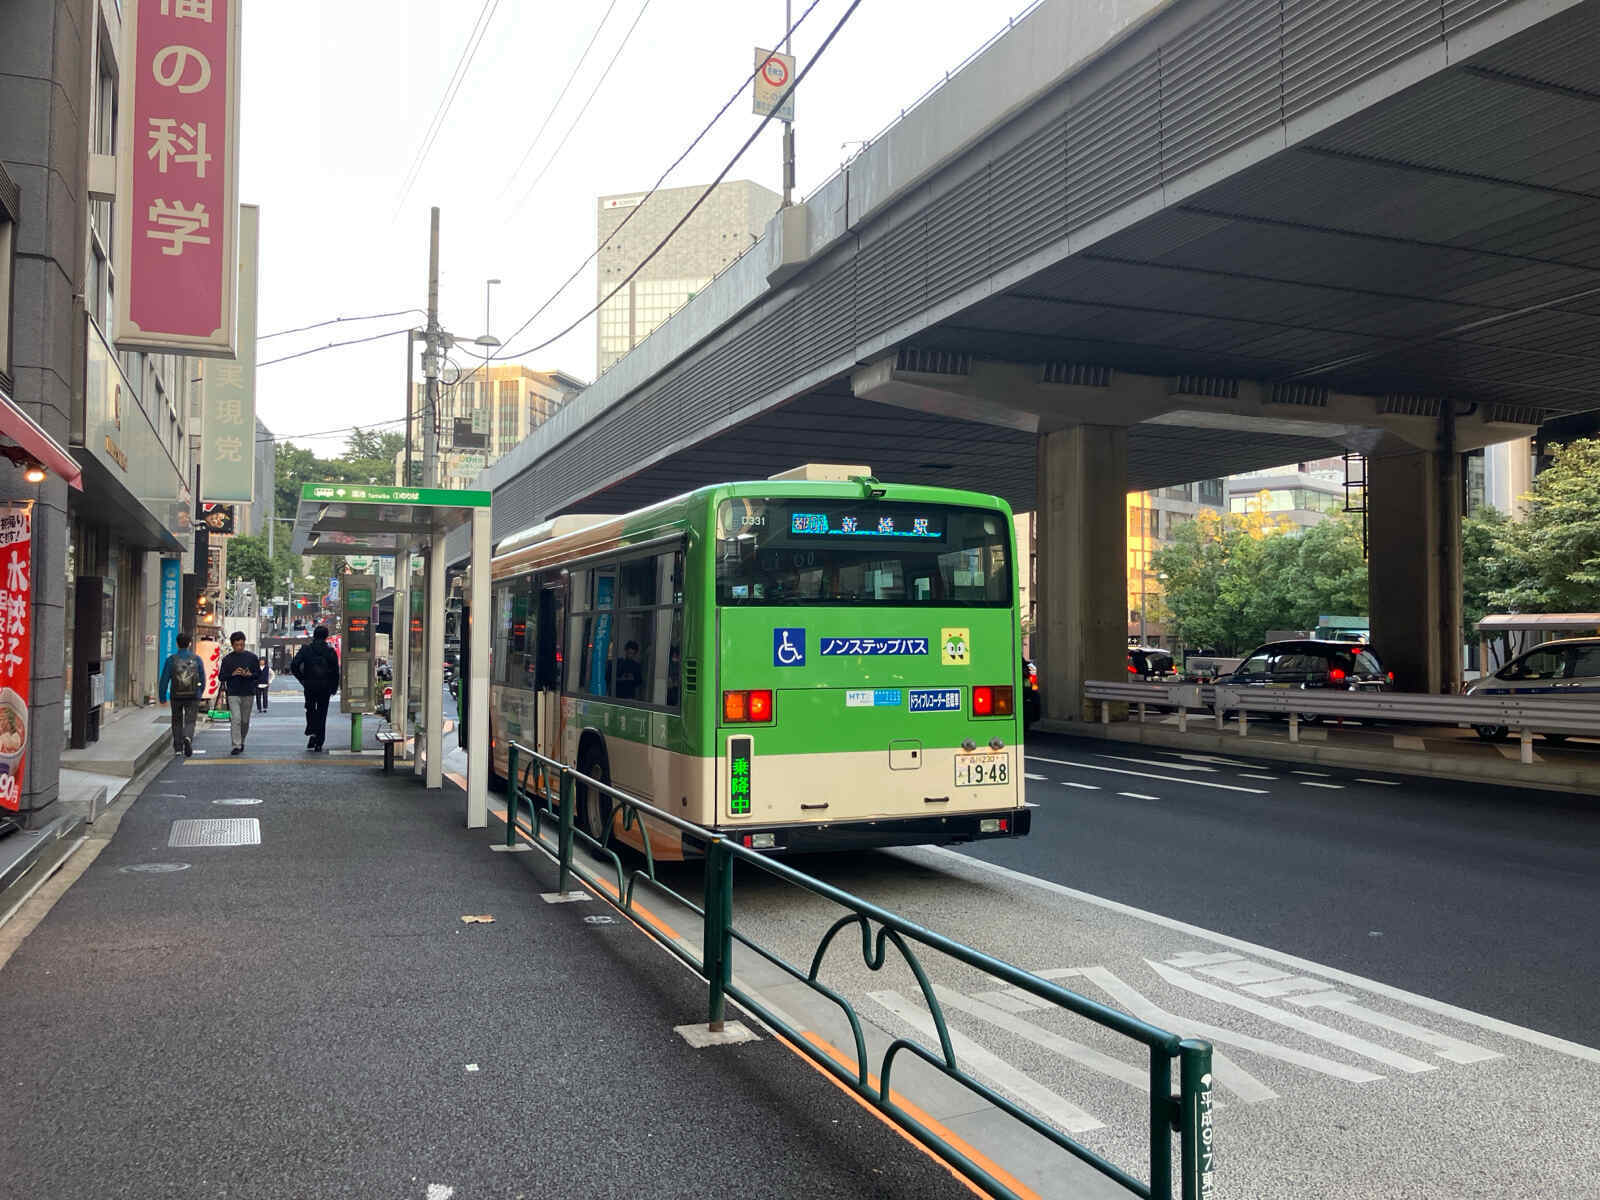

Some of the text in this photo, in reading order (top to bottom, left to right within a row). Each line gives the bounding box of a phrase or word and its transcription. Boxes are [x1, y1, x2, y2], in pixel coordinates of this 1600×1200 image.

[822, 639, 927, 655] ノンステップバス
[731, 757, 750, 815] 乗降中
